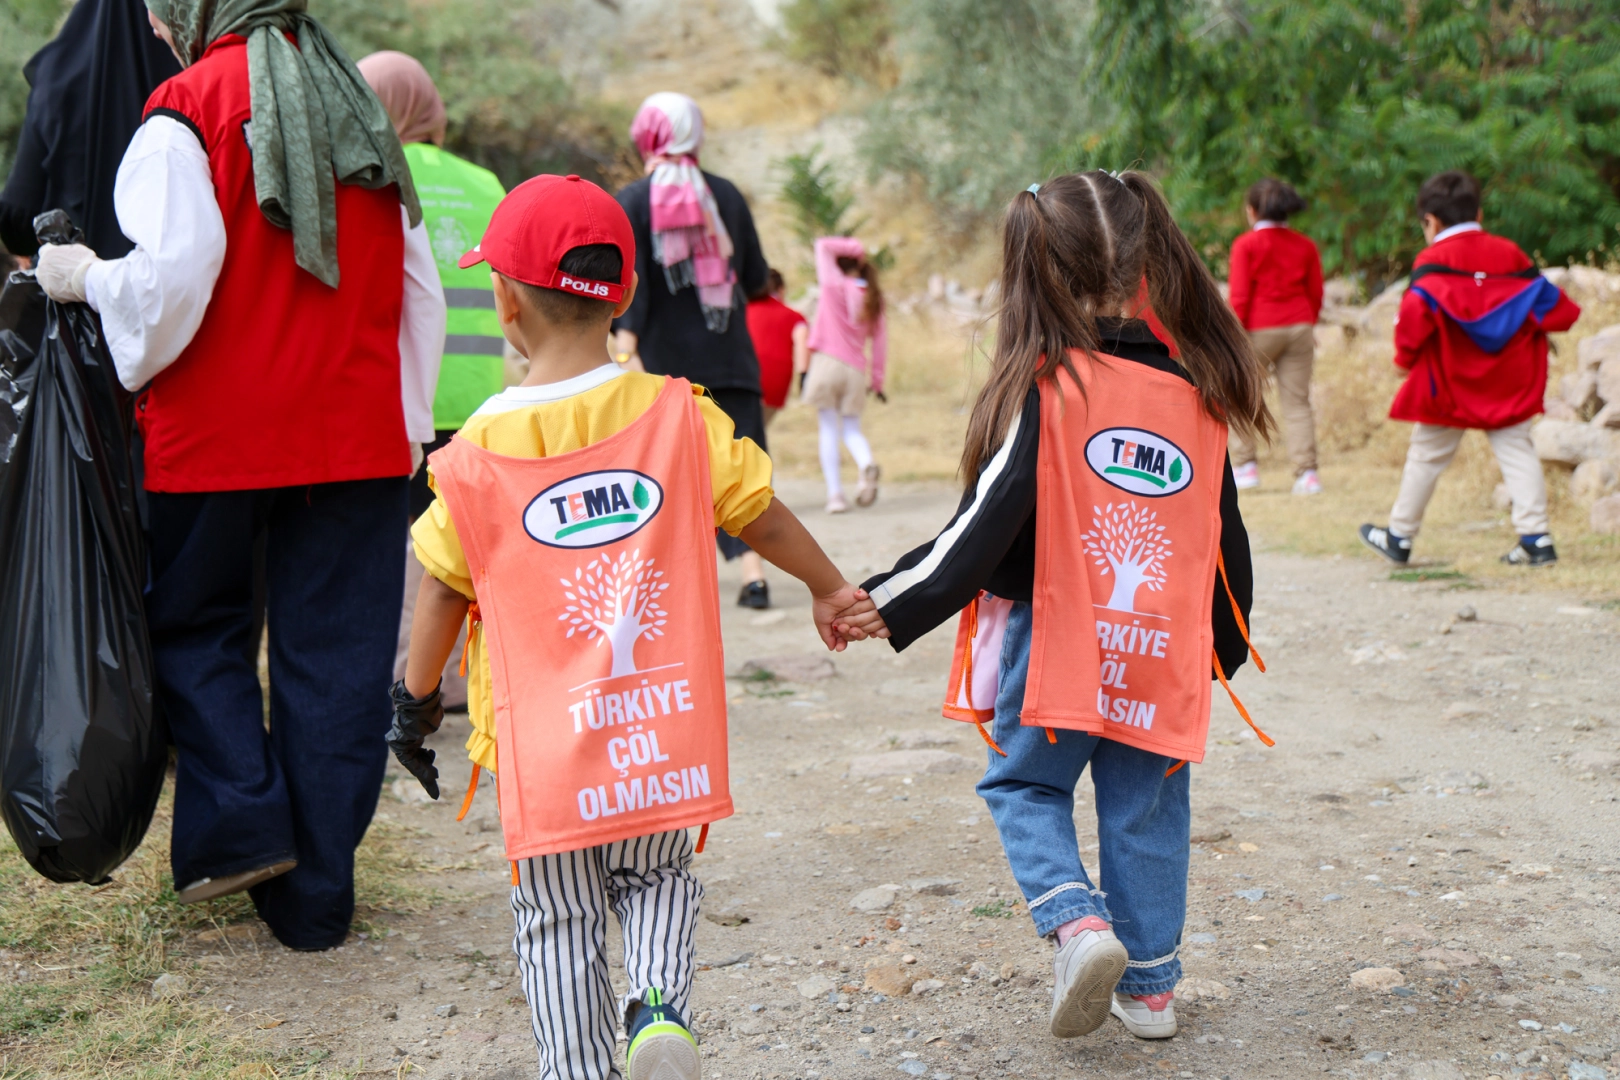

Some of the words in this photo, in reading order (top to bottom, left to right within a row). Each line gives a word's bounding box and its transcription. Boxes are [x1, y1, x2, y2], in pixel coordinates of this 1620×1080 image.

[1111, 437, 1165, 476] TEMA
[550, 483, 630, 524] TEMA
[1095, 620, 1170, 658] RKİYE
[1100, 653, 1128, 690] ÖL
[568, 678, 694, 734] TÜRKİYE
[607, 725, 669, 777] ÇÖL
[577, 764, 711, 822] OLMASIN
